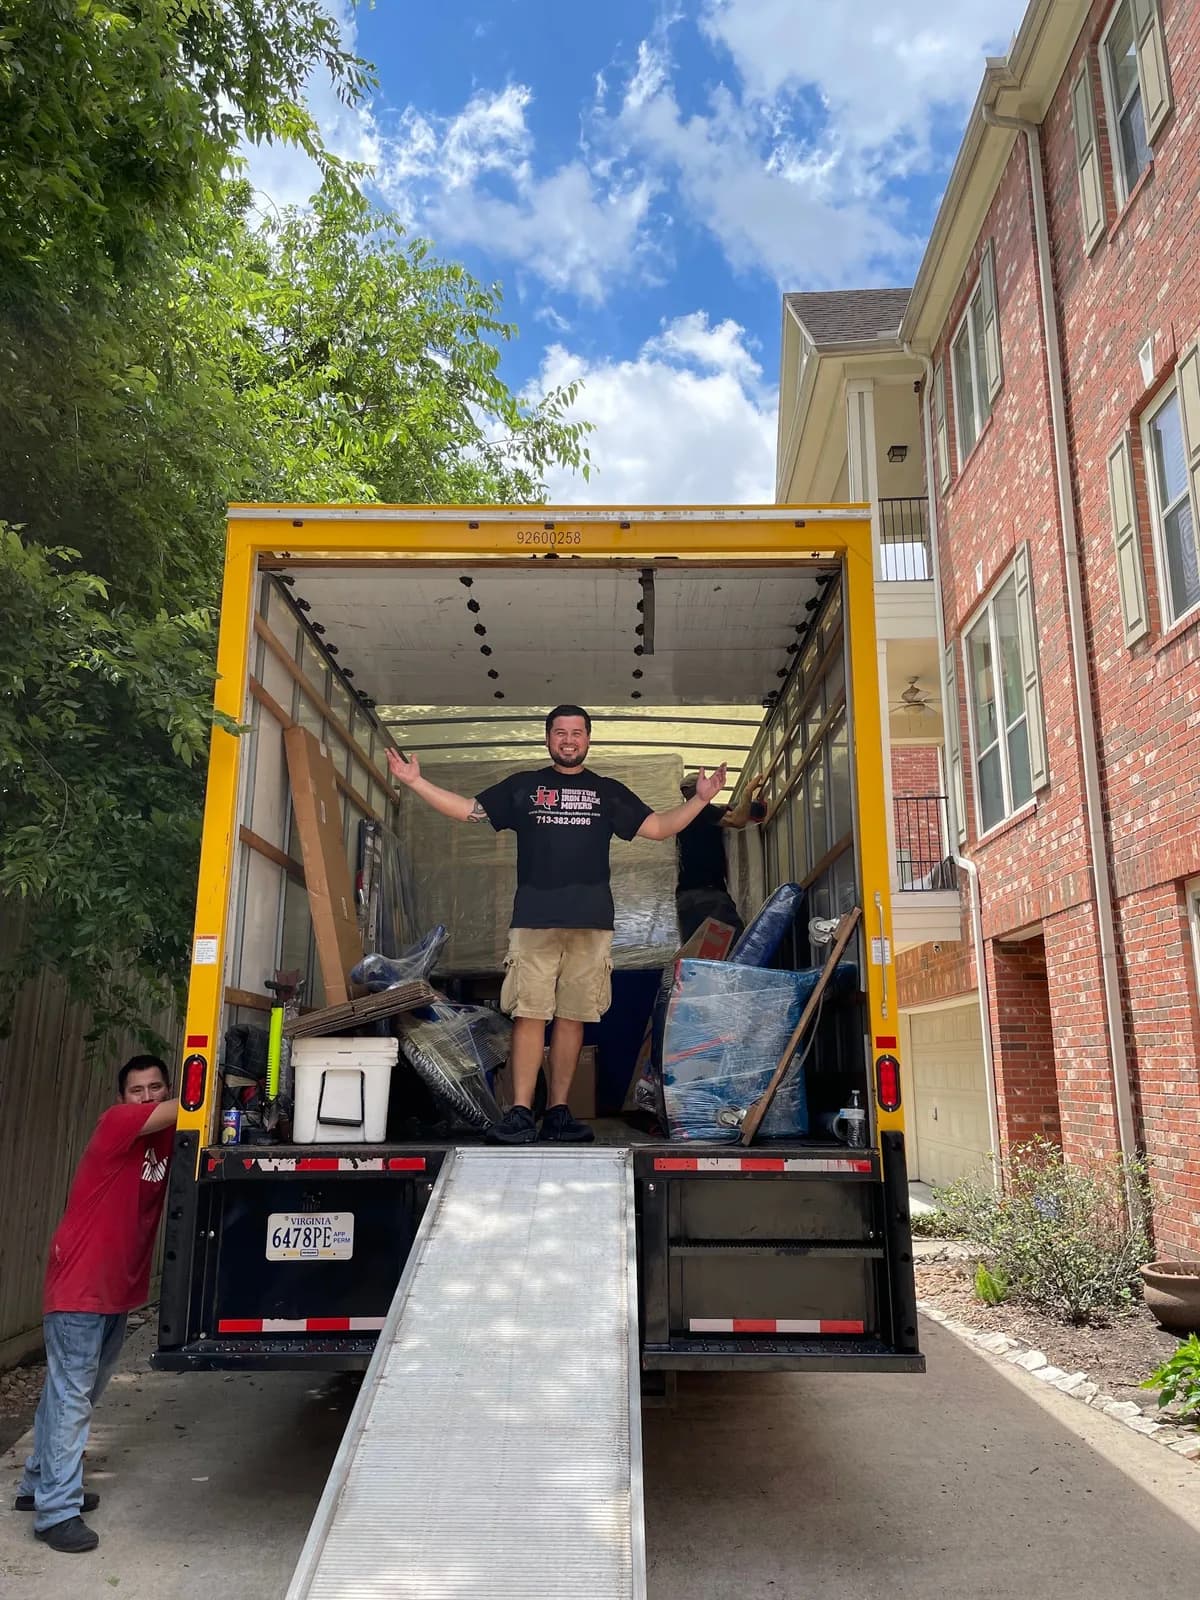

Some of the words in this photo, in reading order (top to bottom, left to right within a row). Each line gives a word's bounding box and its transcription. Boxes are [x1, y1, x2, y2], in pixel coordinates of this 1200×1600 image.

[517, 532, 581, 544] 92600258
[562, 789, 596, 797] HOUSTON
[582, 795, 601, 804] BACK
[536, 816, 591, 825] 713-382-0996
[291, 1217, 331, 1225] VIRGINIA
[272, 1227, 332, 1248] 6478PE
